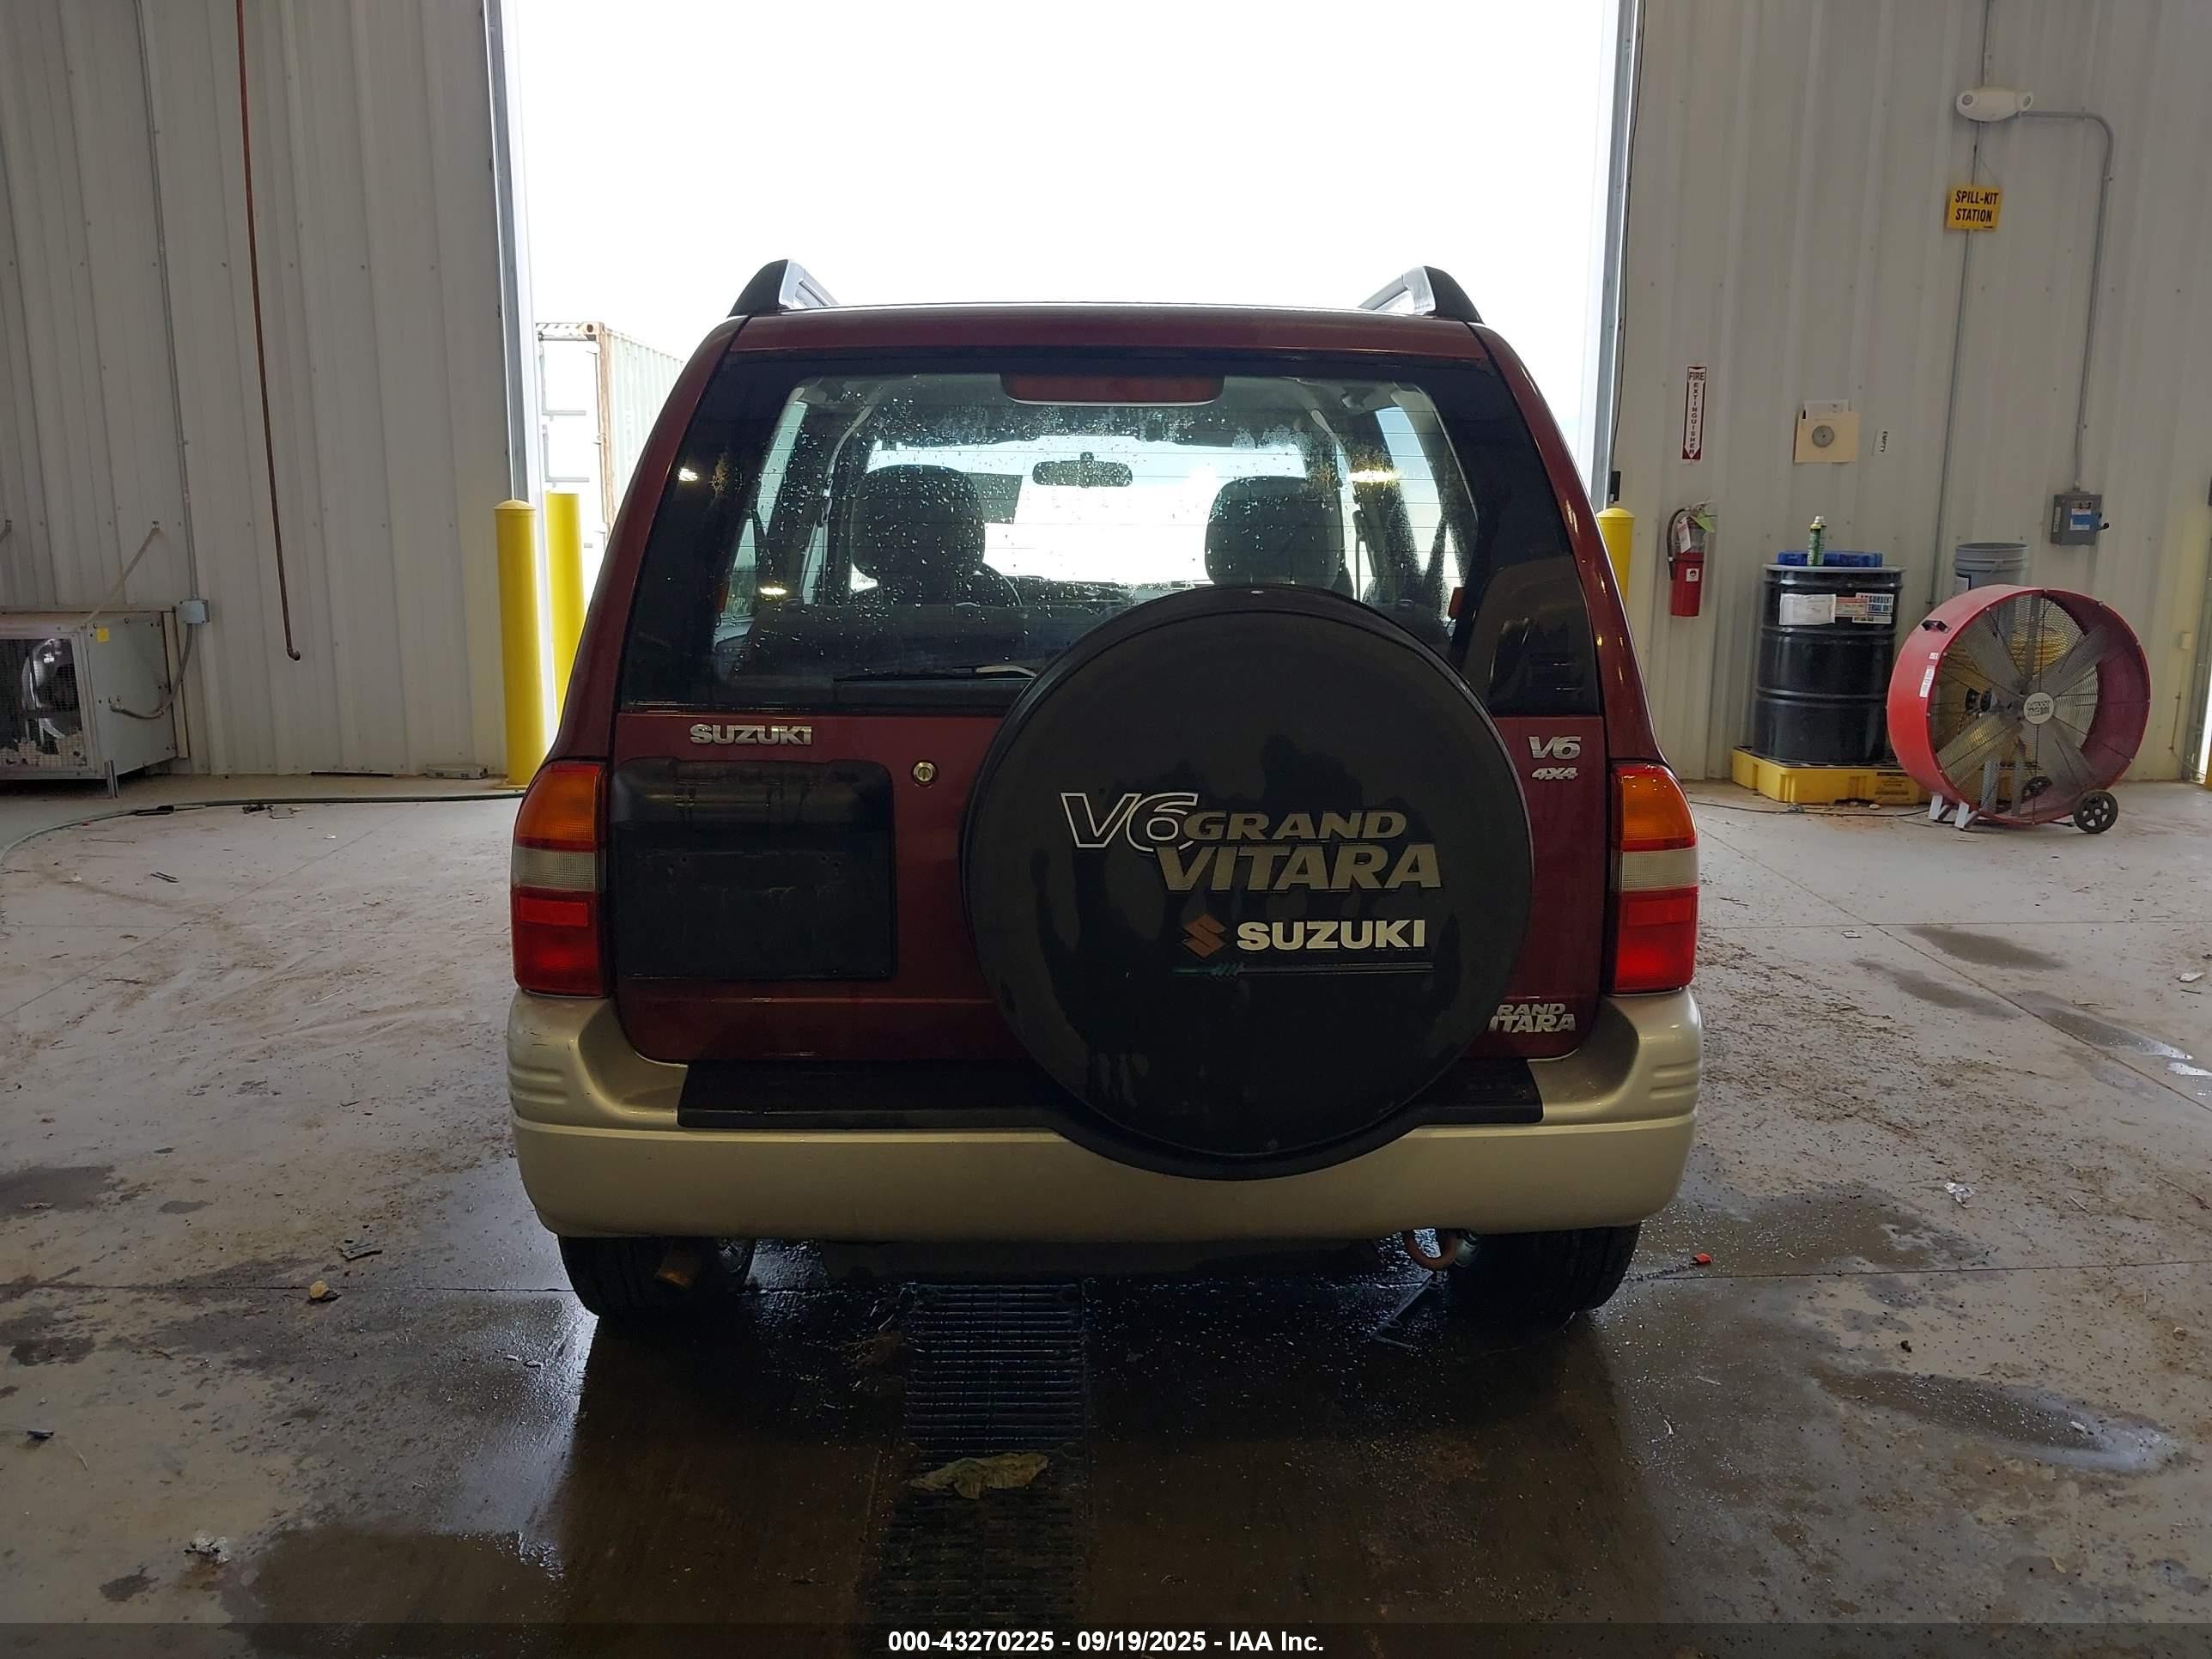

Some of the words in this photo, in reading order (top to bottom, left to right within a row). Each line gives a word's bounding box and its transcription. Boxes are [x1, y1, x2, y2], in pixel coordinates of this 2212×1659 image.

[1955, 190, 1999, 205] SPILL-KIT
[1955, 208, 1993, 222] STATION
[1689, 372, 1705, 380] FIRE
[1689, 382, 1699, 454] EXTINGUISHER
[690, 724, 812, 745] SUZUKI
[1528, 736, 1582, 760] V6
[1060, 792, 1199, 852] V6
[1183, 811, 1407, 841] GRAND
[1157, 843, 1442, 891] VITARA
[1237, 920, 1426, 951] SUZUKI
[1496, 1003, 1566, 1017] RAND
[1488, 1014, 1577, 1033] ITARA
